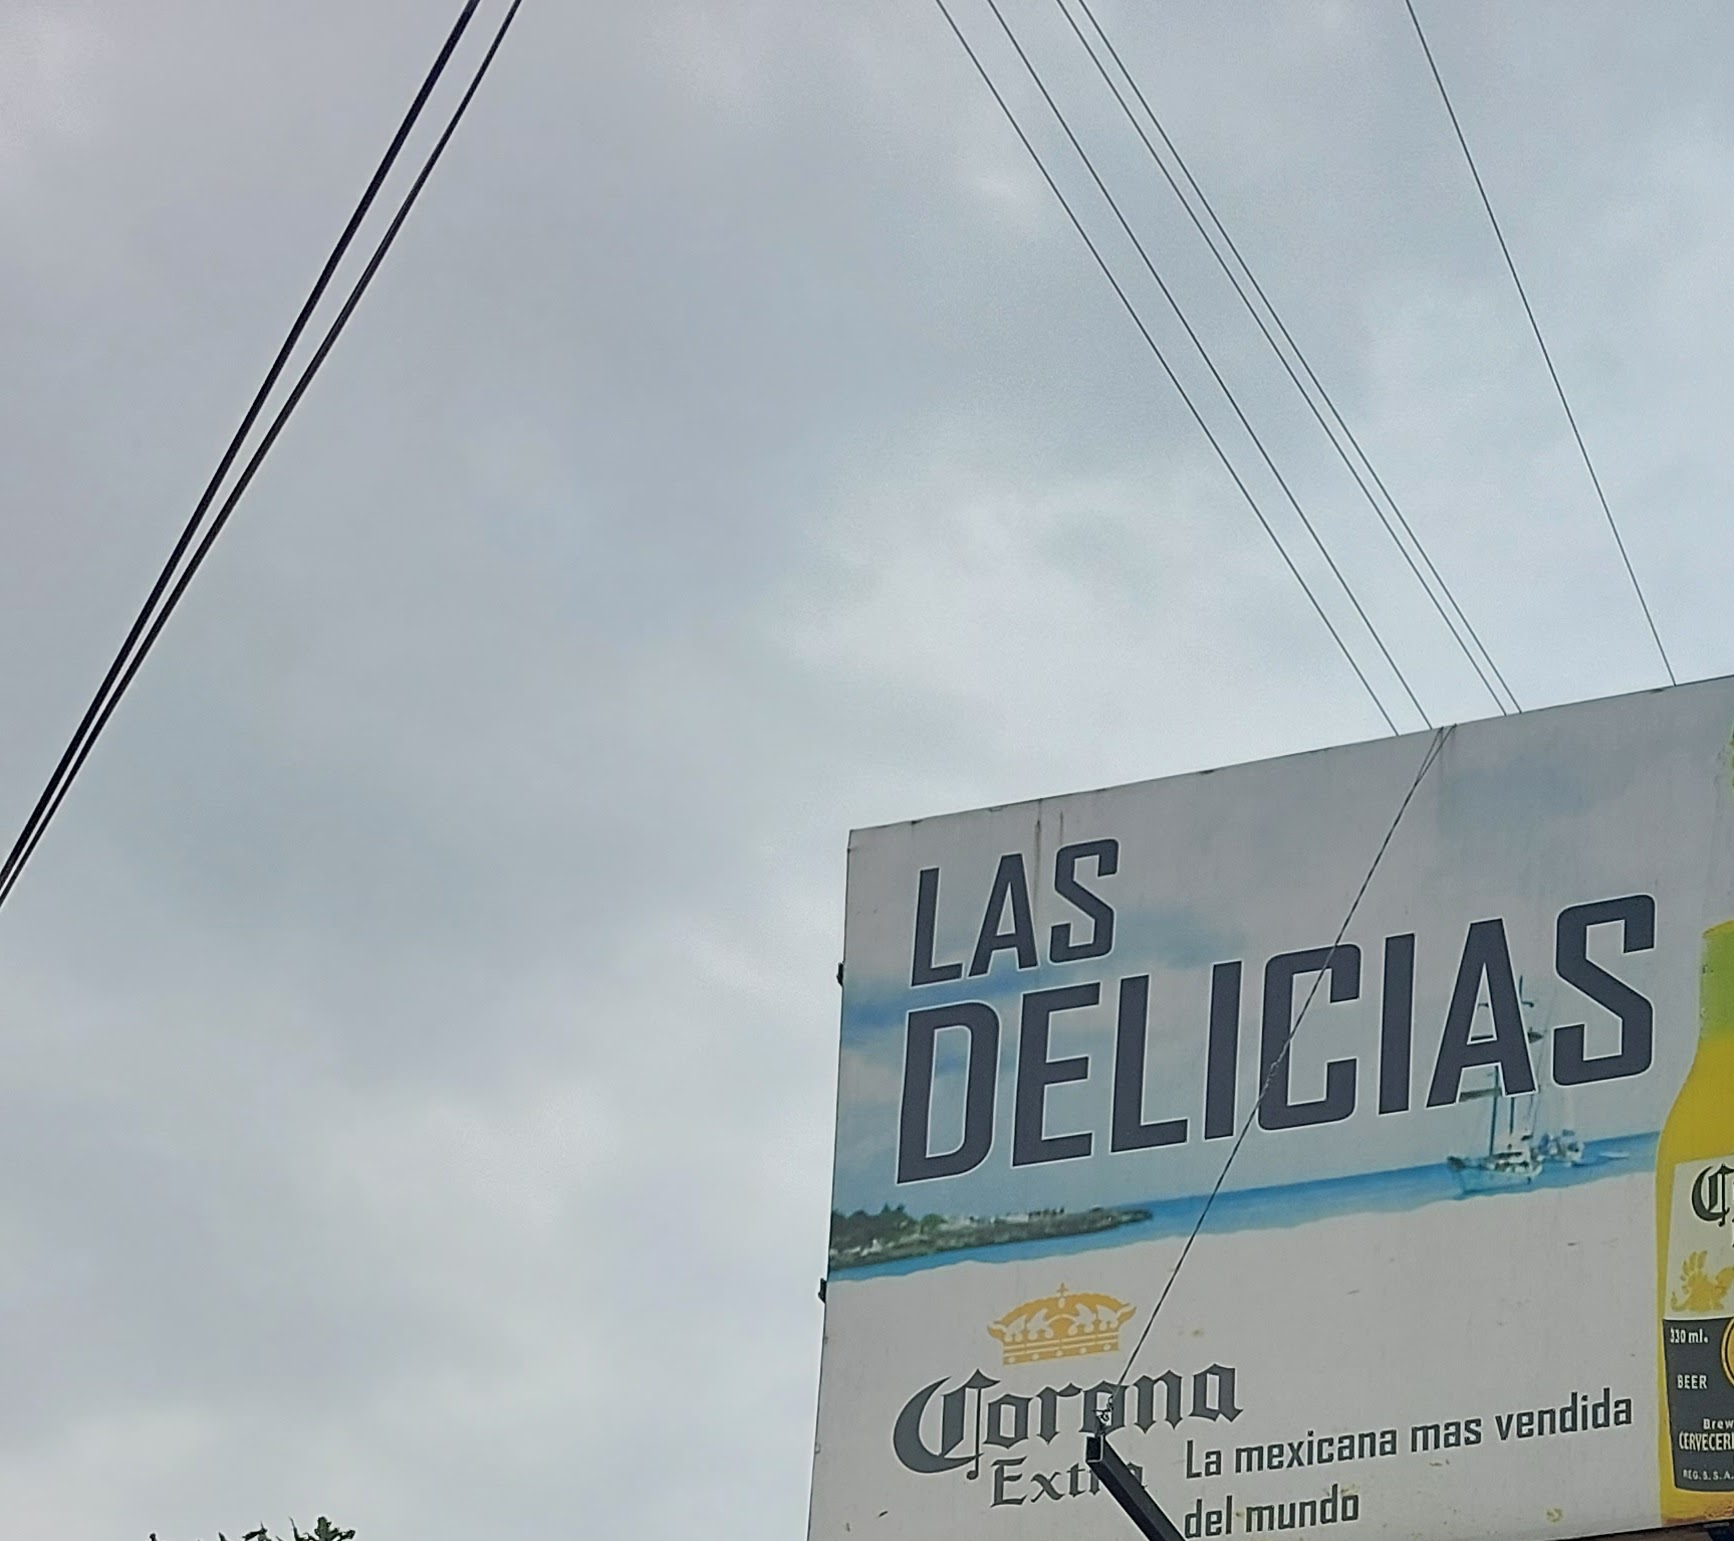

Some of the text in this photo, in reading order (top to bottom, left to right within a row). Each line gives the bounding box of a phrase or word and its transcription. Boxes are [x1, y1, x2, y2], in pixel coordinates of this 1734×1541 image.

[909, 838, 1120, 988] LAS
[897, 894, 1656, 1185] DELICIAS
[893, 1363, 1244, 1481] Corona
[1186, 1387, 1634, 1480] La mexicana mas vendida
[1676, 1374, 1708, 1390] BEER
[1184, 1484, 1359, 1540] del mundo
